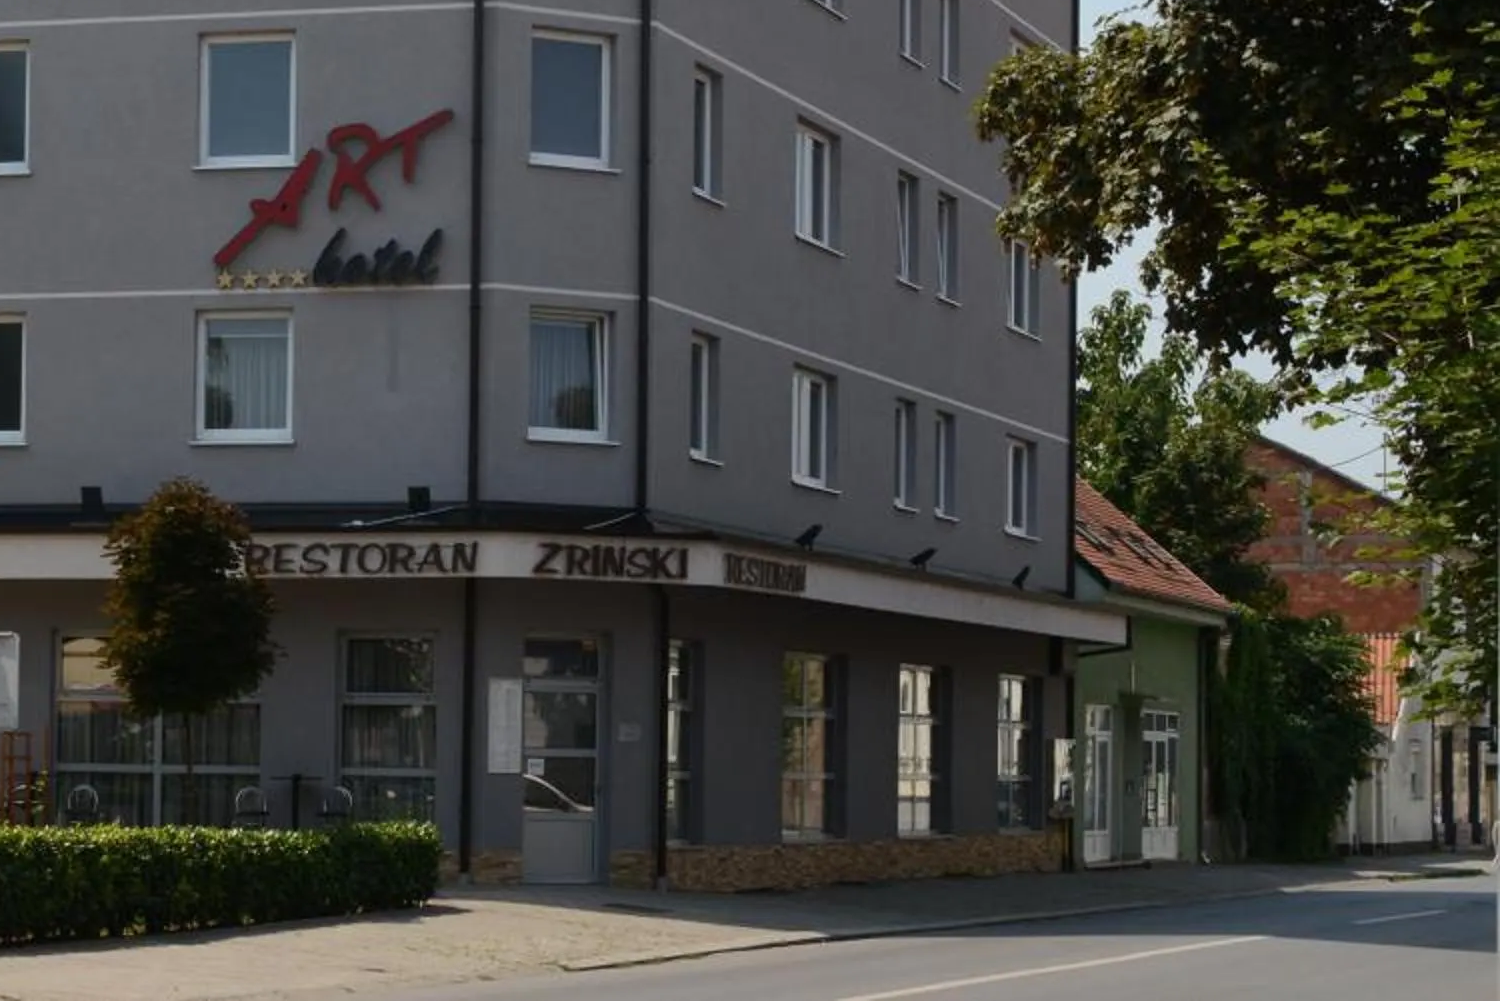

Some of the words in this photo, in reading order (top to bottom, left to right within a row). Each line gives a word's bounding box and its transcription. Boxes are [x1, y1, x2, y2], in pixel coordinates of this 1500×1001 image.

[213, 109, 454, 267] ART
[313, 227, 444, 286] hotel
[247, 540, 479, 575] RESTORAN
[532, 542, 690, 580] ZRINSKI
